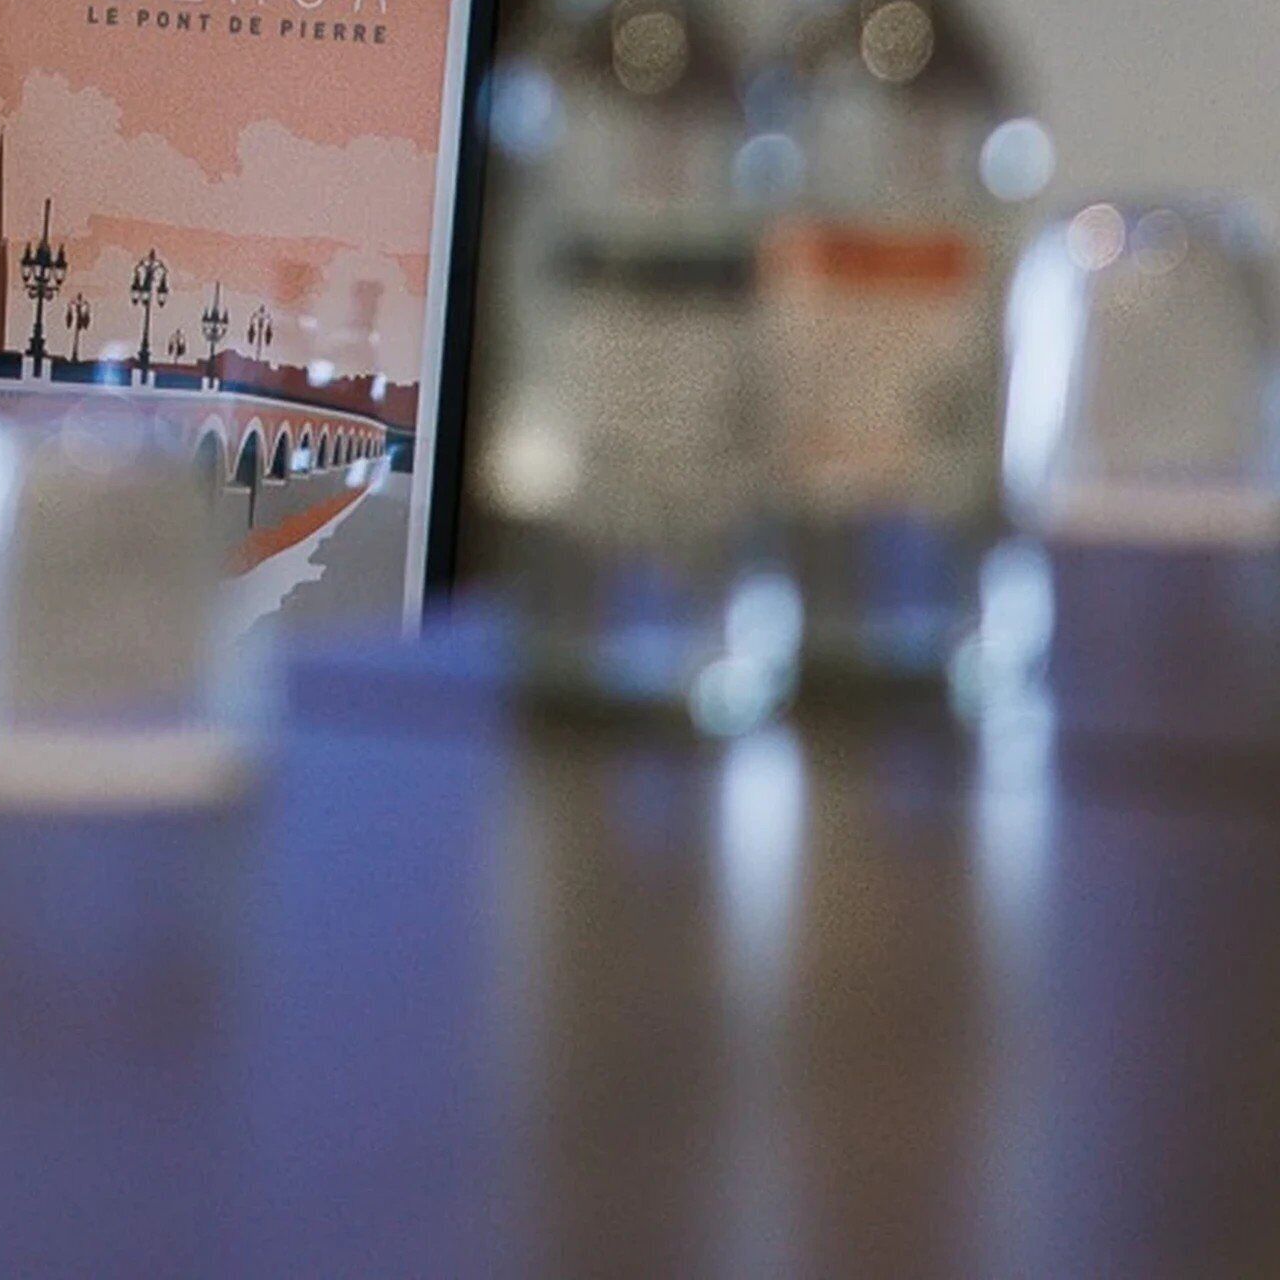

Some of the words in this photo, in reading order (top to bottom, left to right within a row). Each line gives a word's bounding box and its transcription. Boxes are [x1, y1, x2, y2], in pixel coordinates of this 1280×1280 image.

[88, 7, 119, 24] LE
[138, 10, 210, 32] PONT
[230, 15, 262, 34] DE
[281, 20, 387, 44] PIERRE
